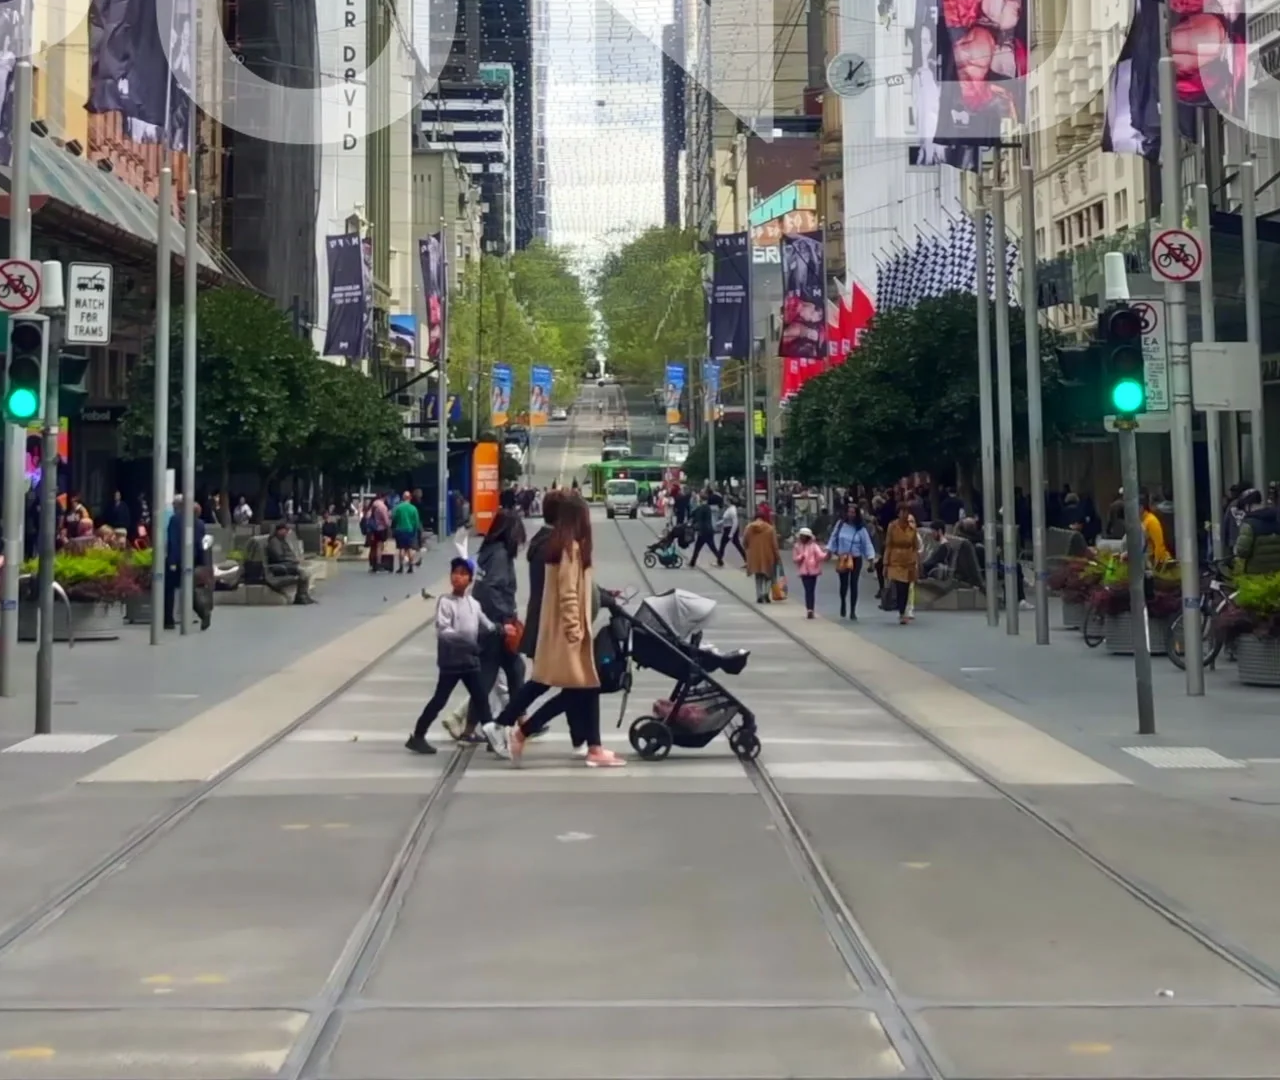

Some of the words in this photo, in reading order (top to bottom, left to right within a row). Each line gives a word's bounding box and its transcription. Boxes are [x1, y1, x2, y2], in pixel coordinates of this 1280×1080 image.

[343, 46, 357, 150] DAVID
[74, 298, 104, 310] WATCH
[81, 312, 98, 323] FOR
[73, 325, 104, 337] TRAMS
